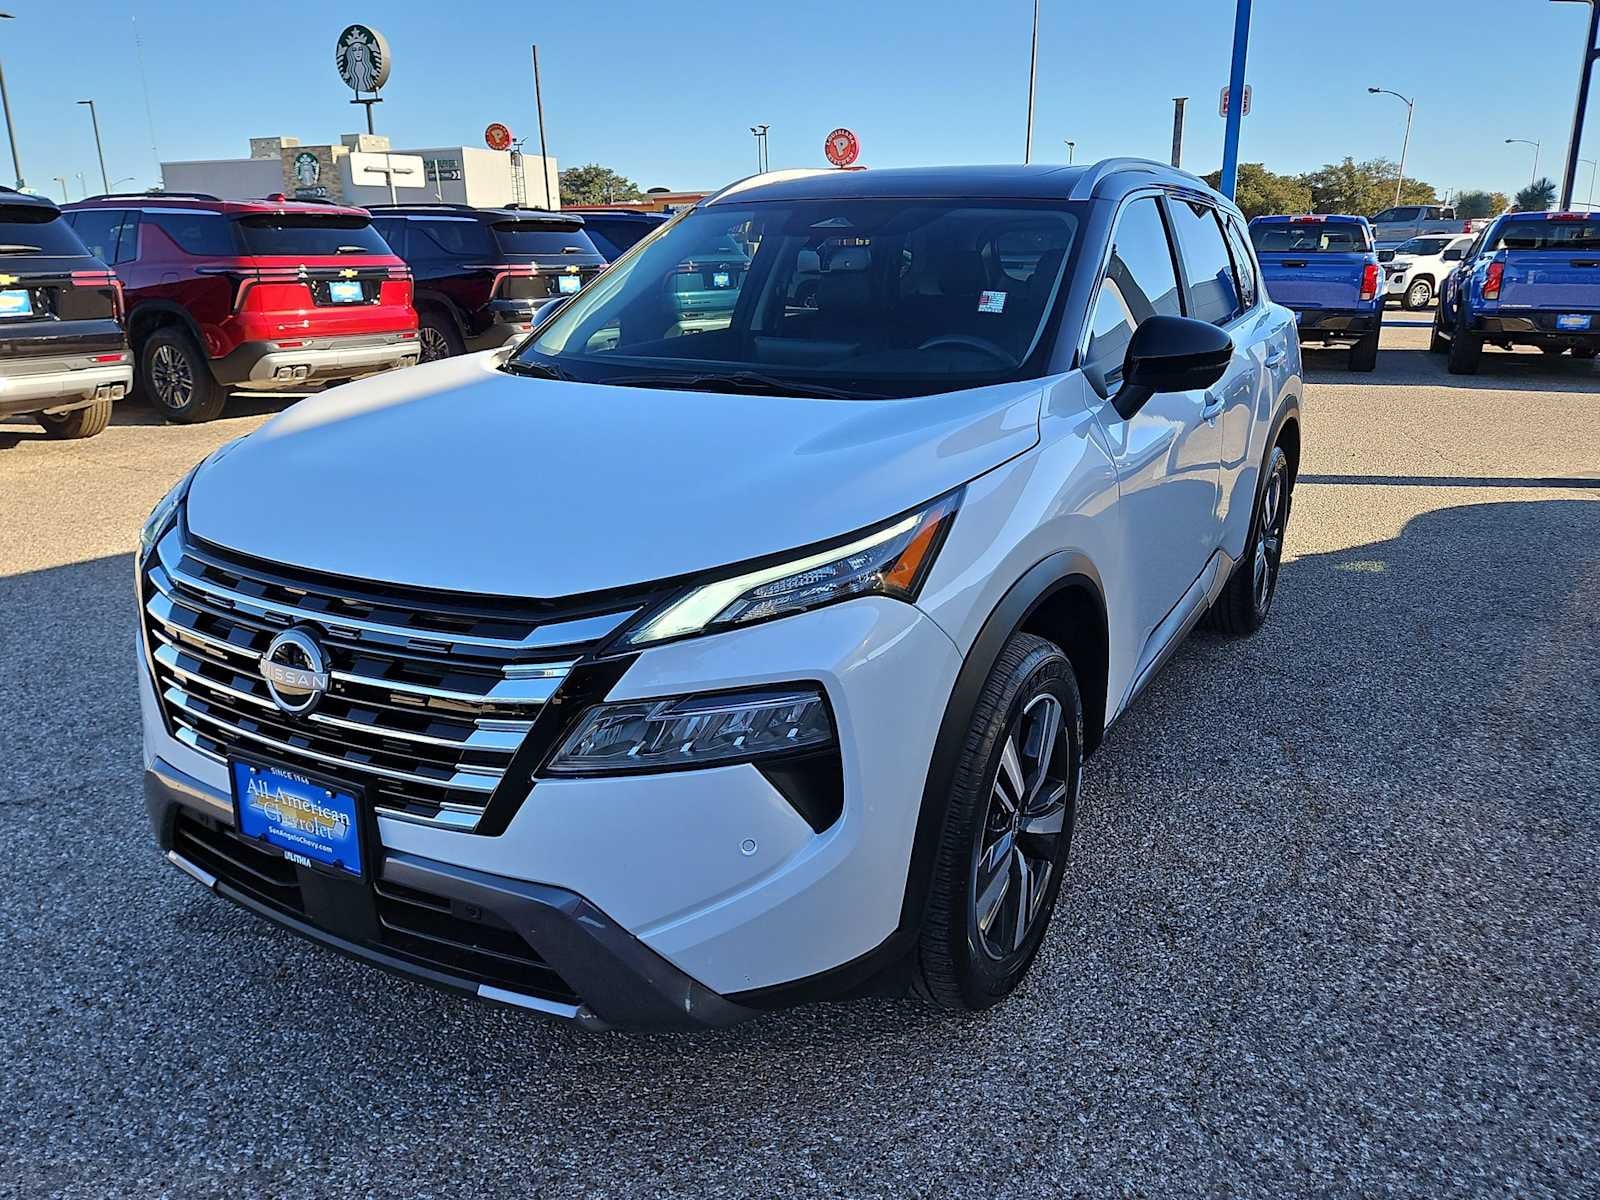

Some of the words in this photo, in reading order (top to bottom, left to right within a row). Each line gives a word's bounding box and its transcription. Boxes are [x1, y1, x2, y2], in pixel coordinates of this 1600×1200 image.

[262, 660, 326, 689] NISSAN
[270, 767, 292, 780] SINCE
[247, 778, 269, 799] All
[274, 787, 351, 826] American
[263, 801, 335, 840] Chevrolet
[268, 825, 333, 854] SanAngeloChevy.com
